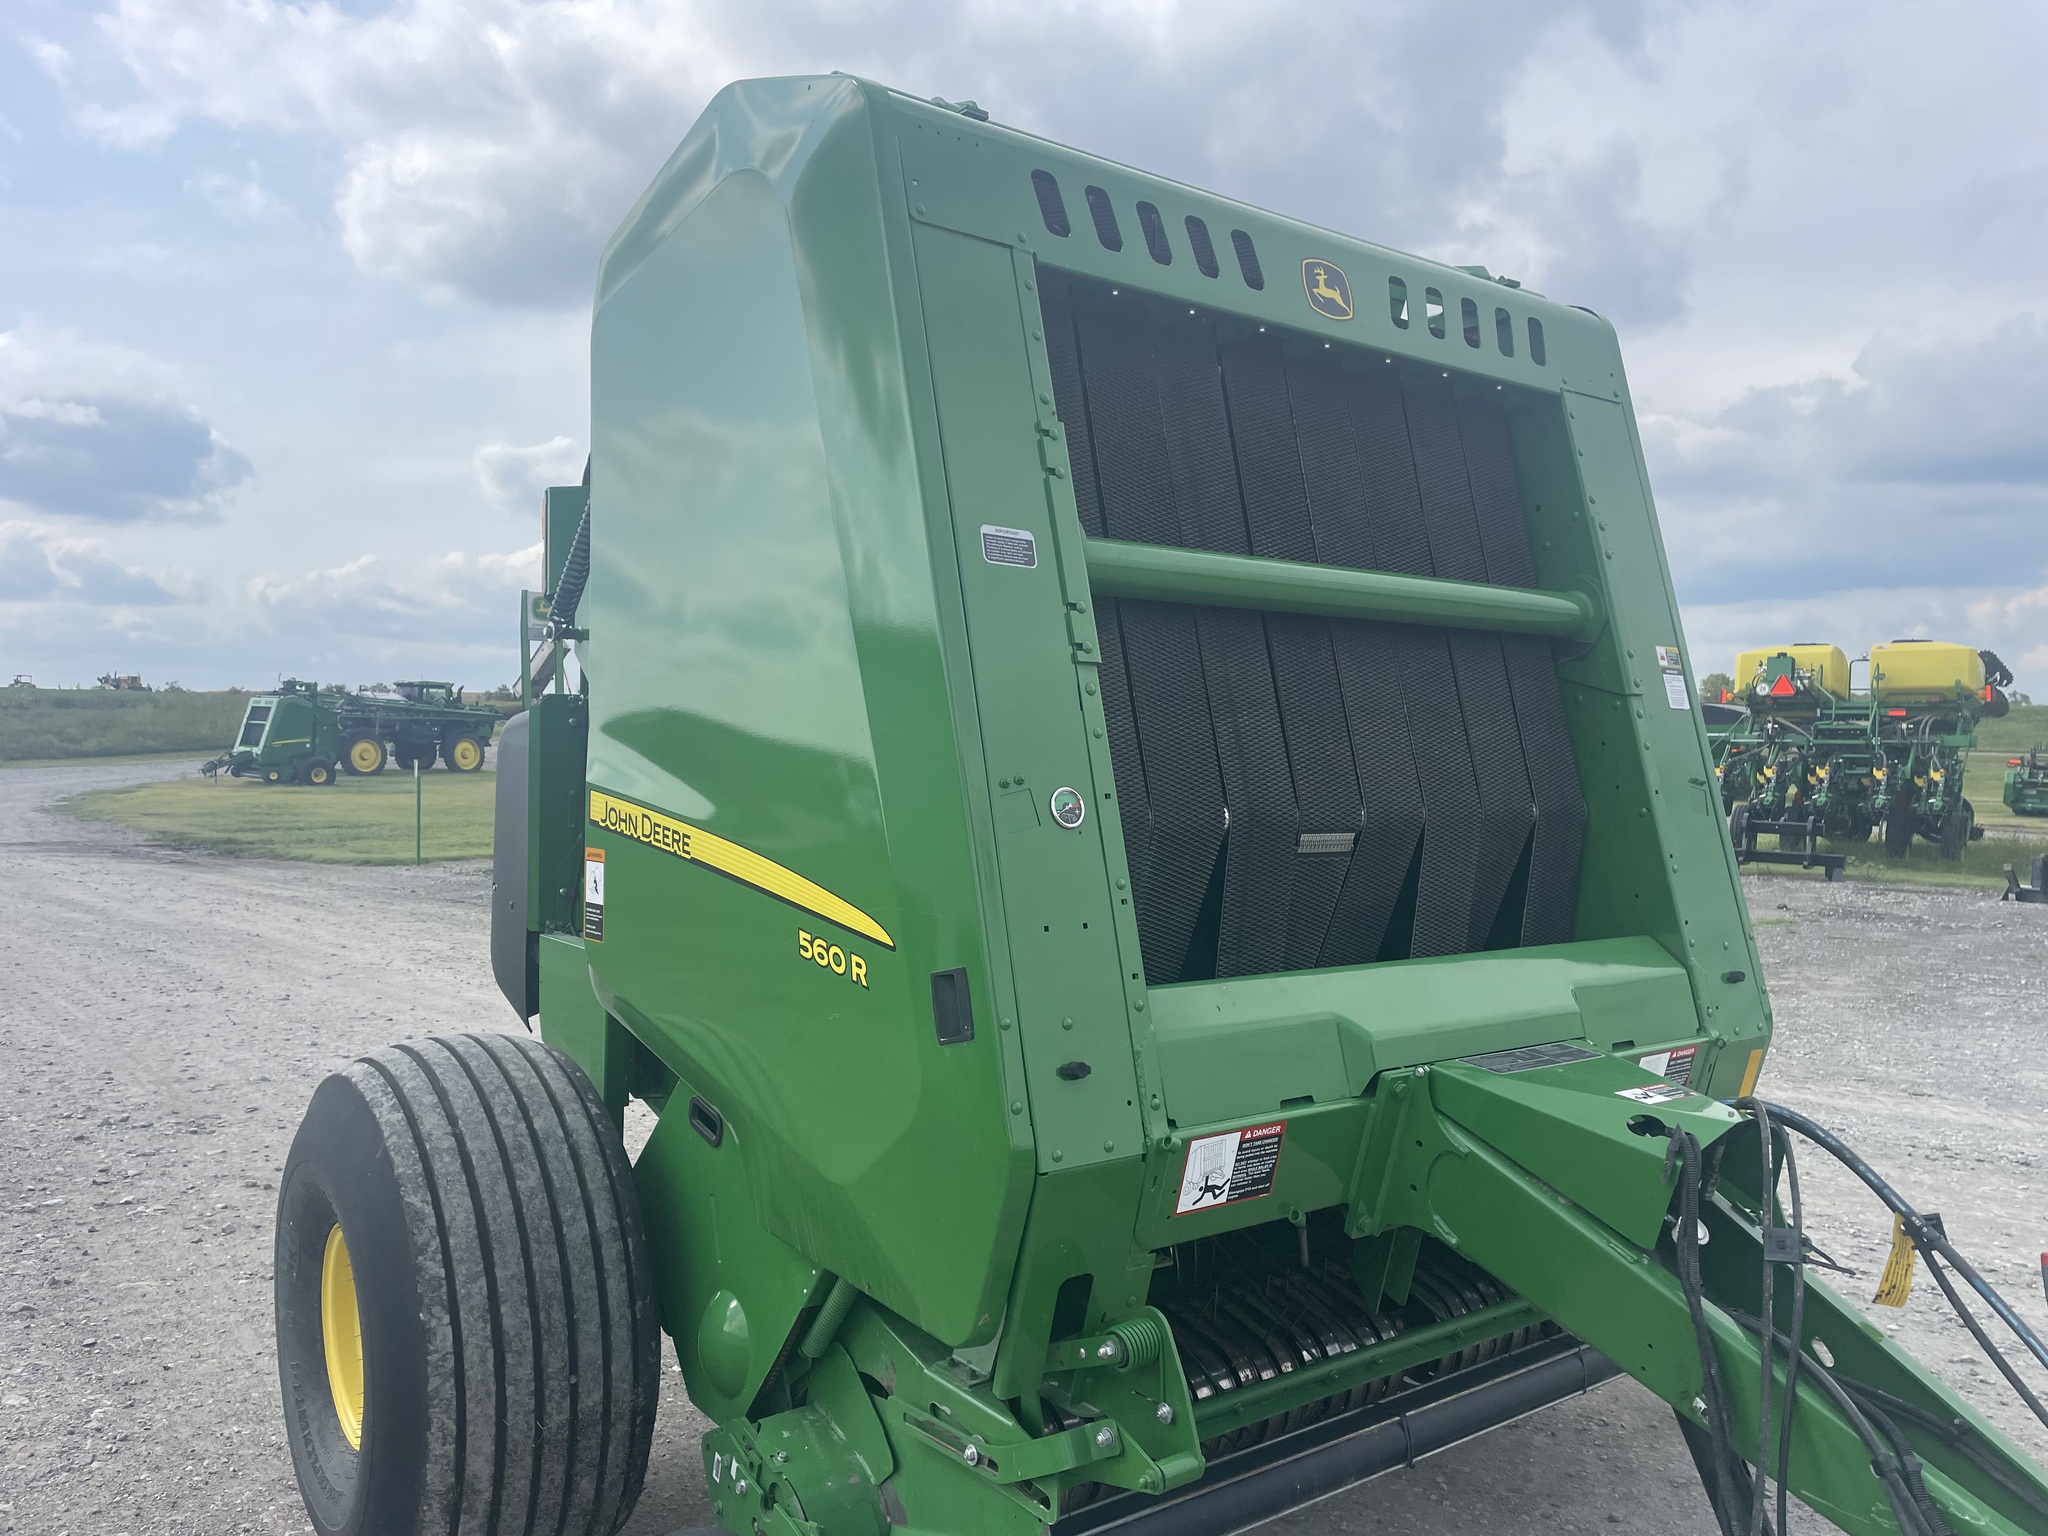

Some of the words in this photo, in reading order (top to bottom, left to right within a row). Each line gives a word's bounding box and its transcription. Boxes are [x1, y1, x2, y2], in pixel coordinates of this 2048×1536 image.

[600, 800, 638, 836] JOHN
[641, 813, 691, 856] DEERE
[1677, 1047, 1695, 1057] DANGER
[1252, 1125, 1282, 1137] DANGER
